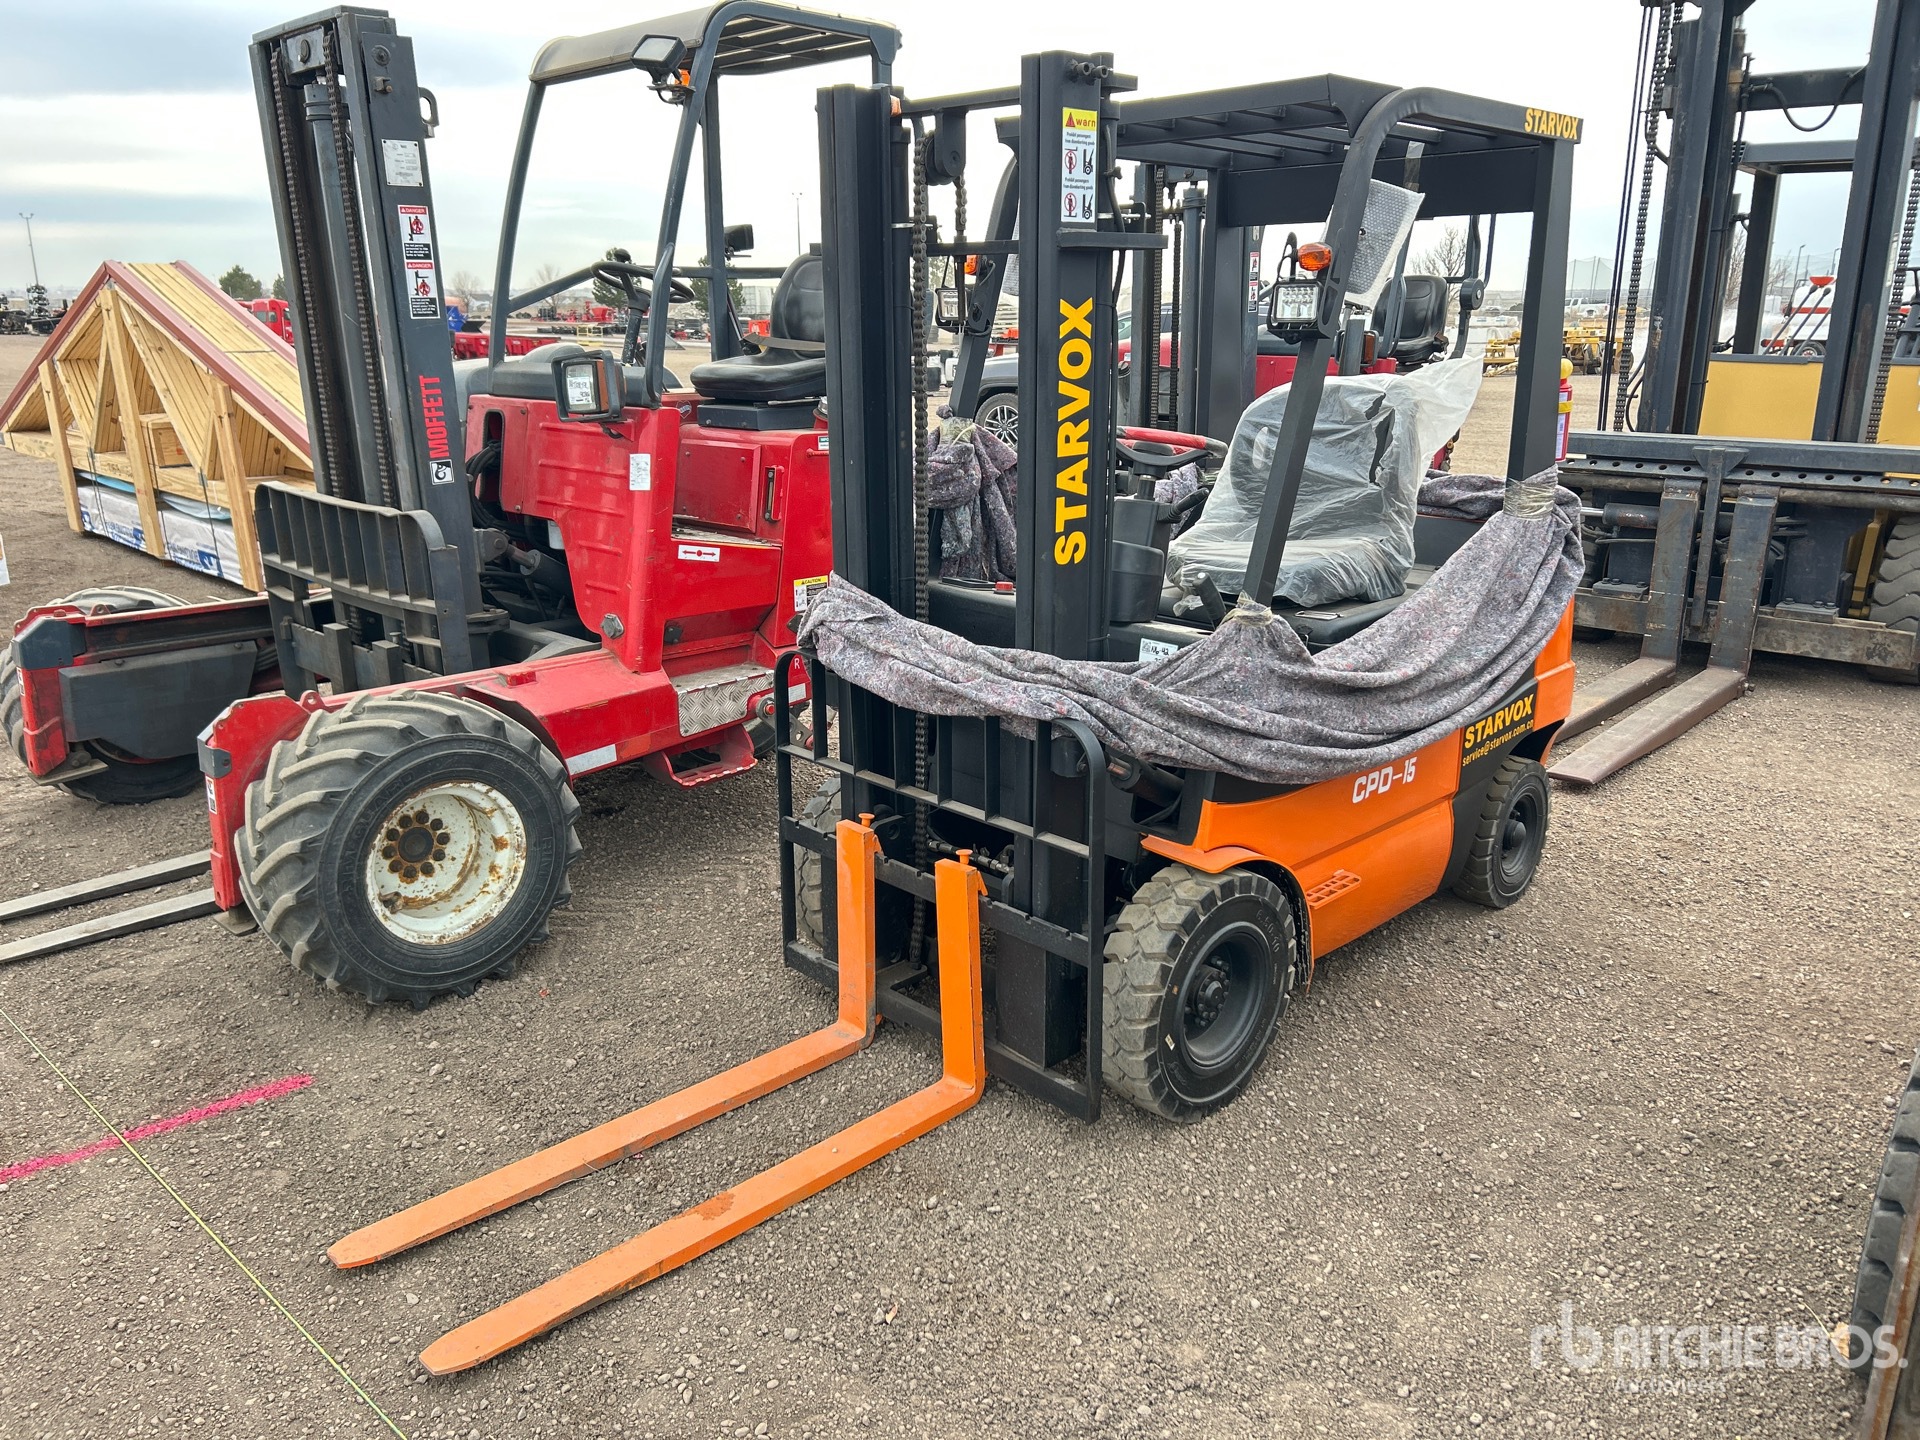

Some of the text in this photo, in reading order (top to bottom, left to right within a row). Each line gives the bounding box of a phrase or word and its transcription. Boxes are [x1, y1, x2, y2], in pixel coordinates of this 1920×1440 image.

[1075, 118, 1096, 128] warn
[1524, 107, 1579, 140] STARVOX
[419, 375, 450, 458] MOFFETT
[1055, 297, 1094, 566] STARVOX
[794, 657, 801, 670] R
[1462, 719, 1535, 767] service@starvox.com.cn
[1465, 694, 1534, 749] STARVOX
[1352, 757, 1417, 804] CPD-15
